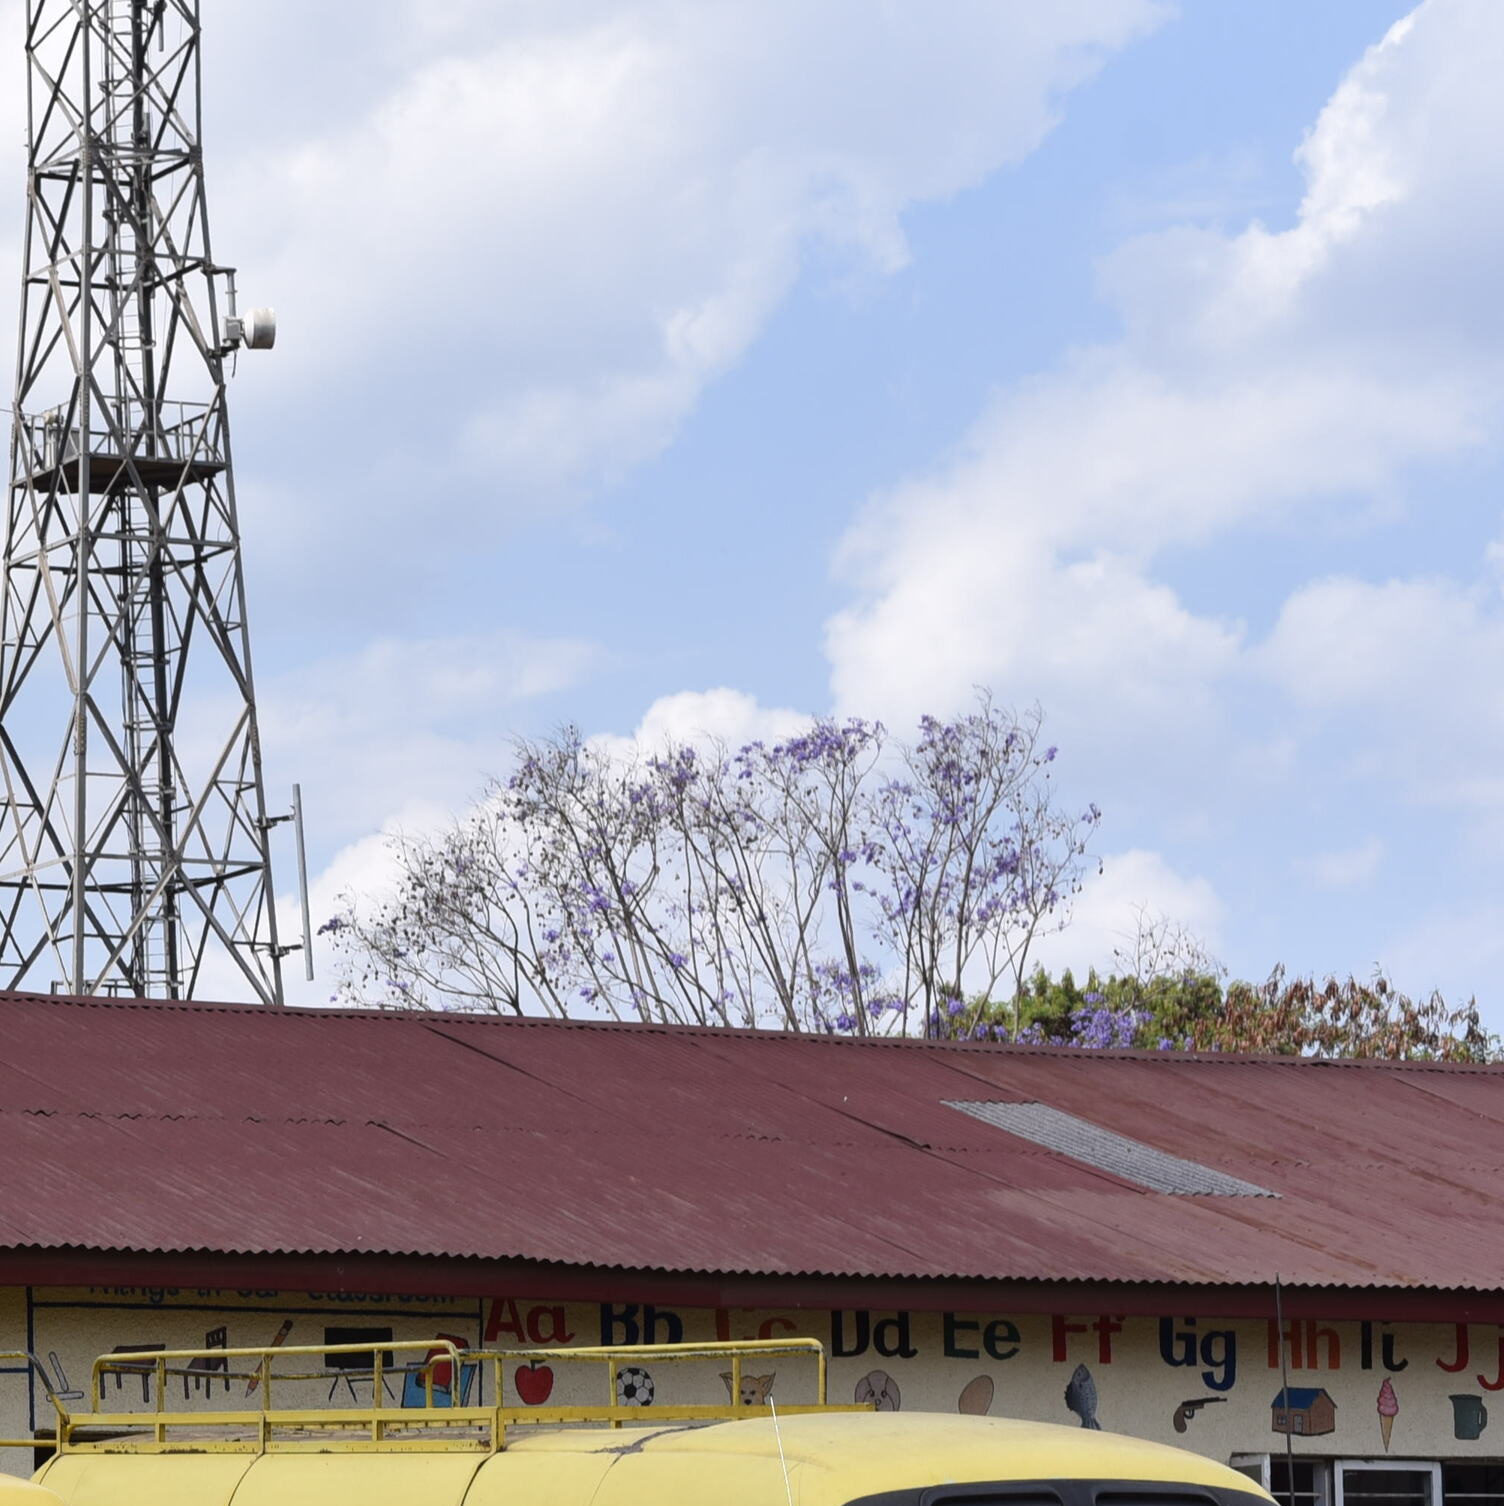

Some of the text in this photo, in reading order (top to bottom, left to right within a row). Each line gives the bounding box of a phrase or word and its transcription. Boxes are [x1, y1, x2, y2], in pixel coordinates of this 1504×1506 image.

[485, 1298, 575, 1344] Aa
[831, 1310, 918, 1358] Dd
[943, 1312, 1021, 1360] Ee
[1052, 1313, 1125, 1364] Ff
[1159, 1316, 1237, 1391] Gg
[1267, 1318, 1341, 1370] Hh
